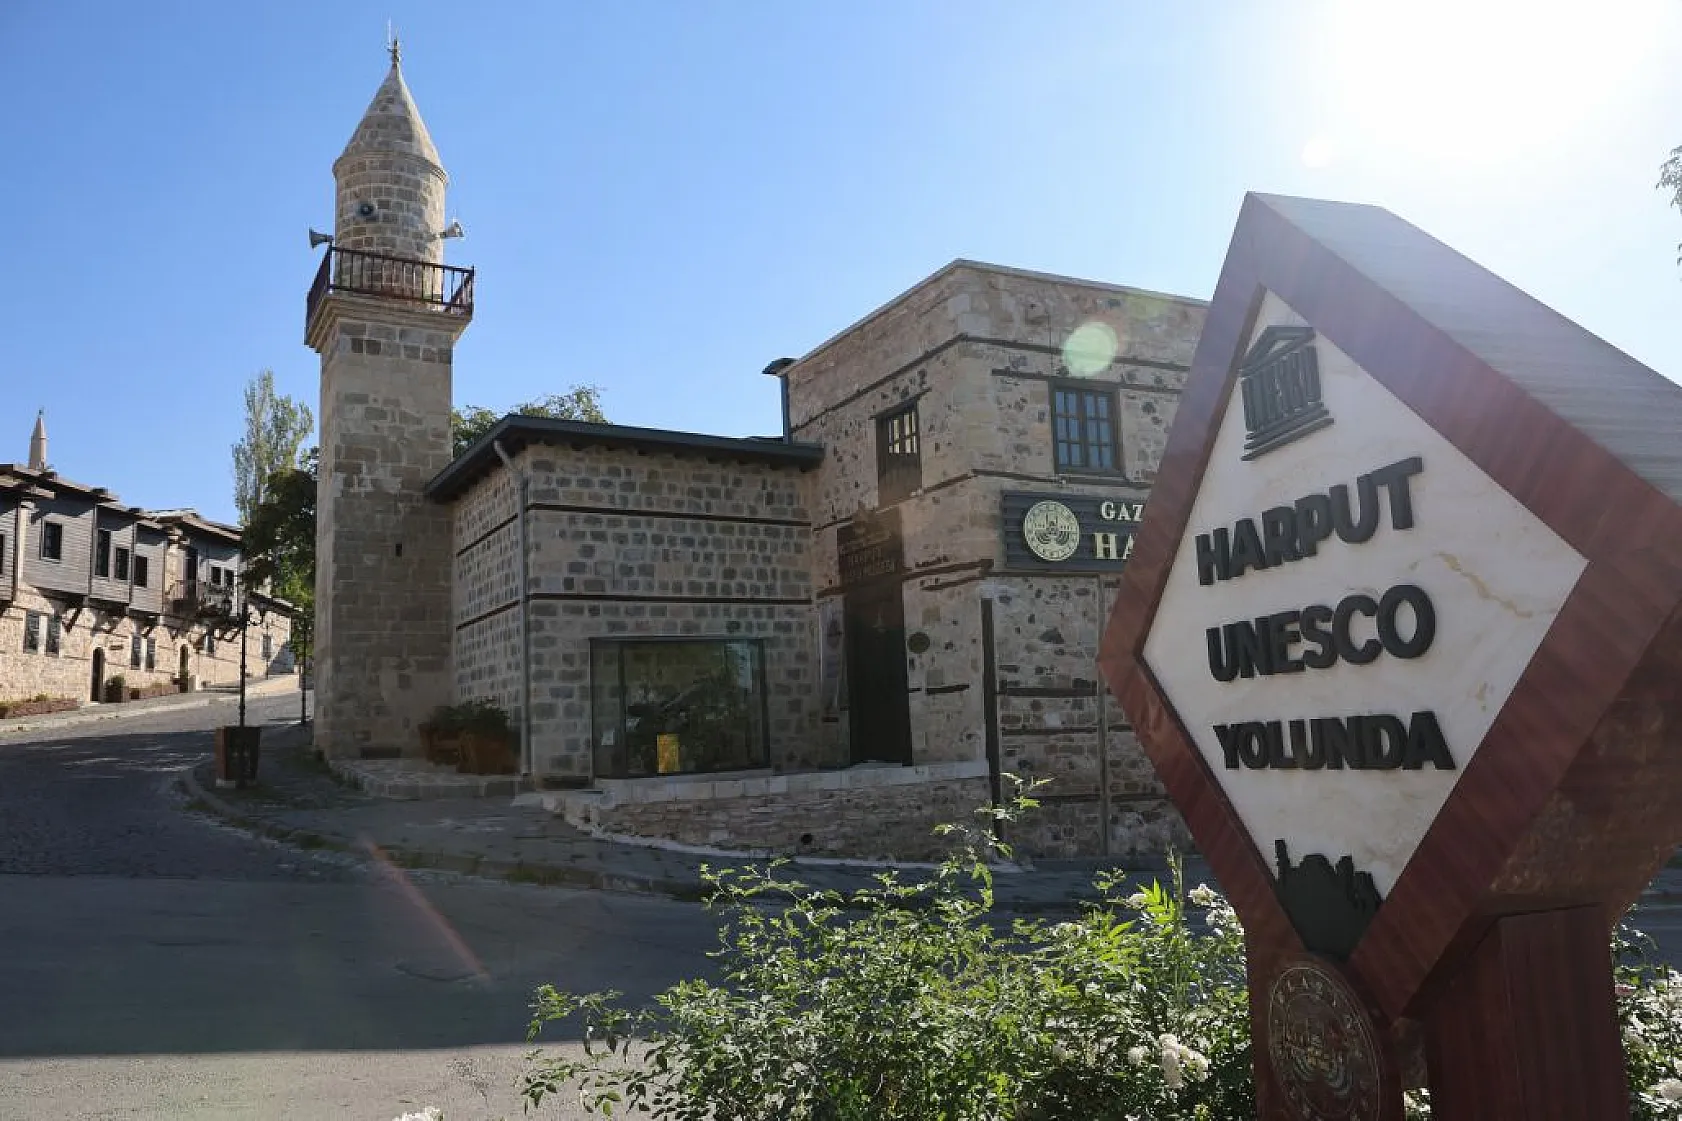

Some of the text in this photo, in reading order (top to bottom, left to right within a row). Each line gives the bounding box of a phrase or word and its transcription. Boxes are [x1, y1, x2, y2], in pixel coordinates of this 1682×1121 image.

[1195, 456, 1423, 585] HARPUT
[1206, 584, 1436, 682] UNESCO
[1212, 711, 1456, 771] YOLUNDA
